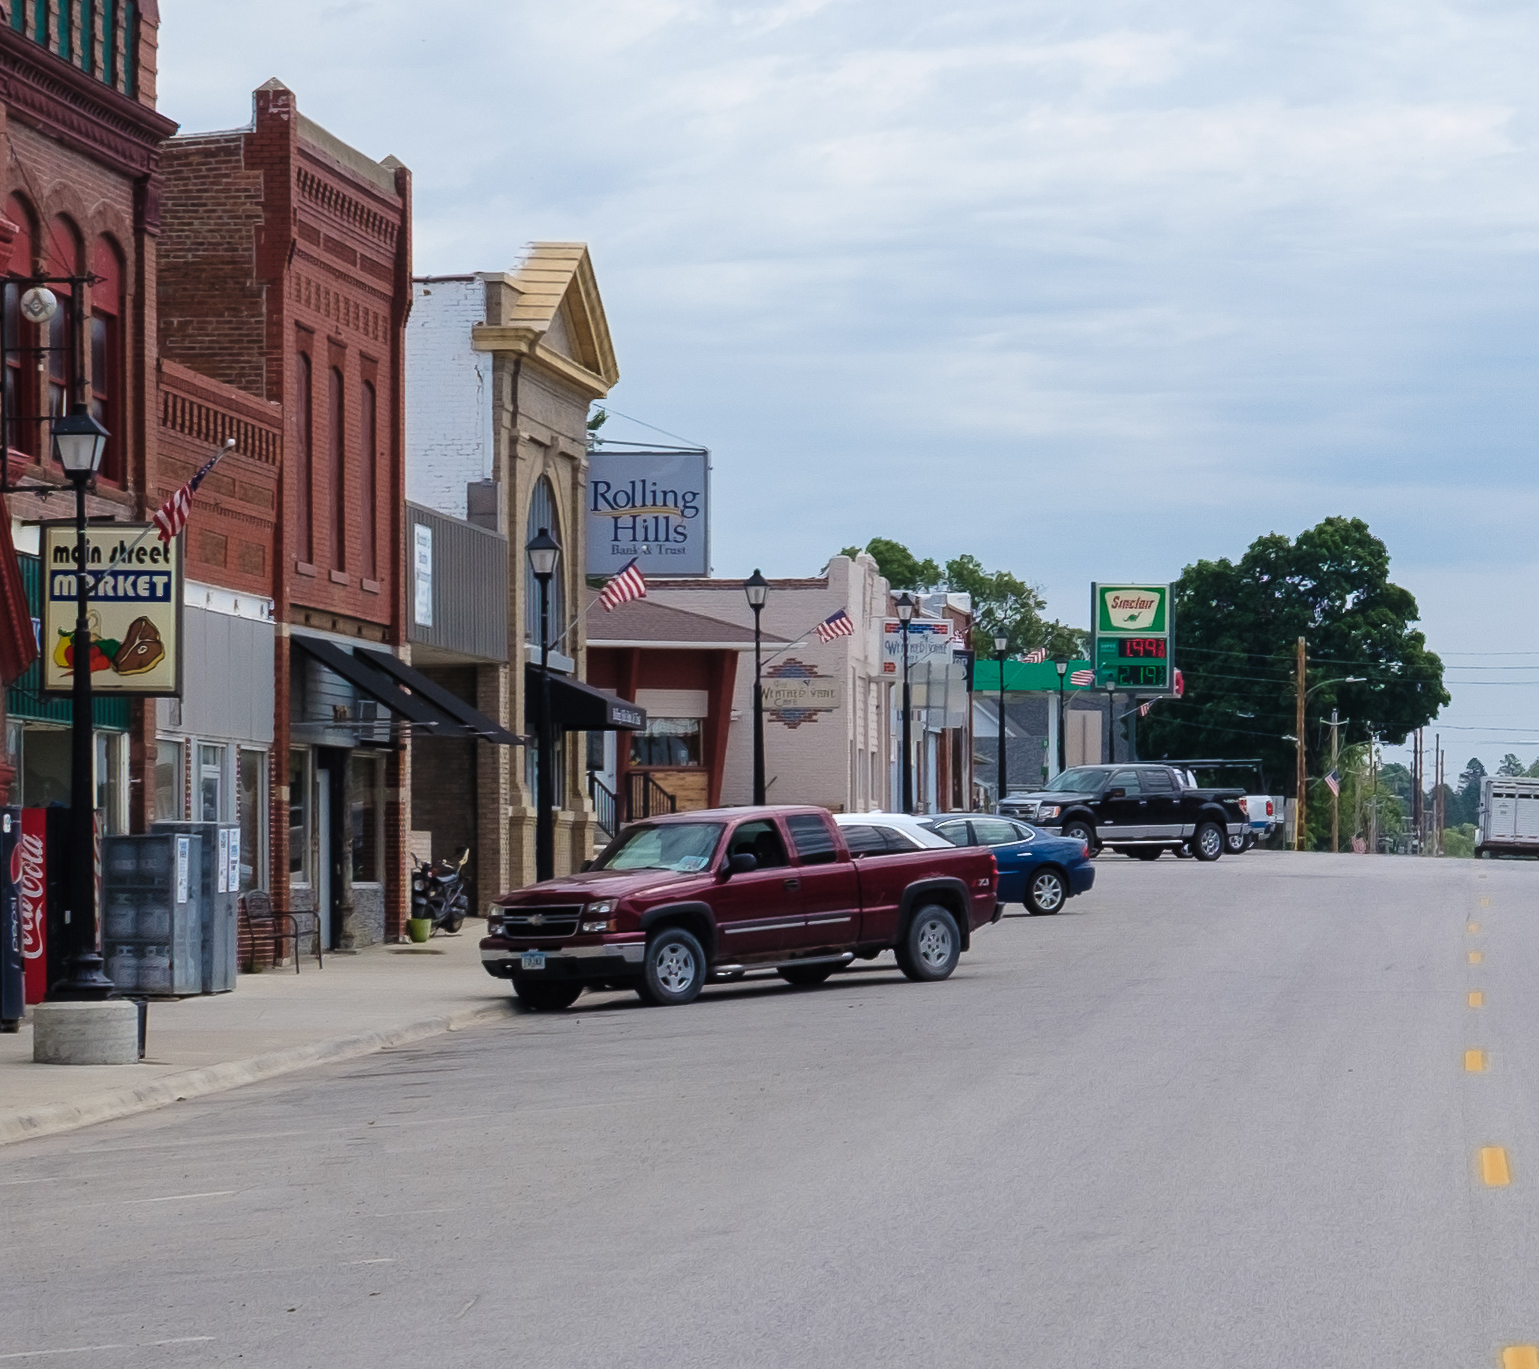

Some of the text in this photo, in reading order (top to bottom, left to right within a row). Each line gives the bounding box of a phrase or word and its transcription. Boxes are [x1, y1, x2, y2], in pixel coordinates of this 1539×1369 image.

[590, 479, 700, 519] Rolling
[610, 514, 688, 544] Hills
[109, 540, 170, 565] street
[611, 544, 639, 555] Bank
[656, 544, 686, 555] Trust
[1111, 595, 1155, 610] Sinclair
